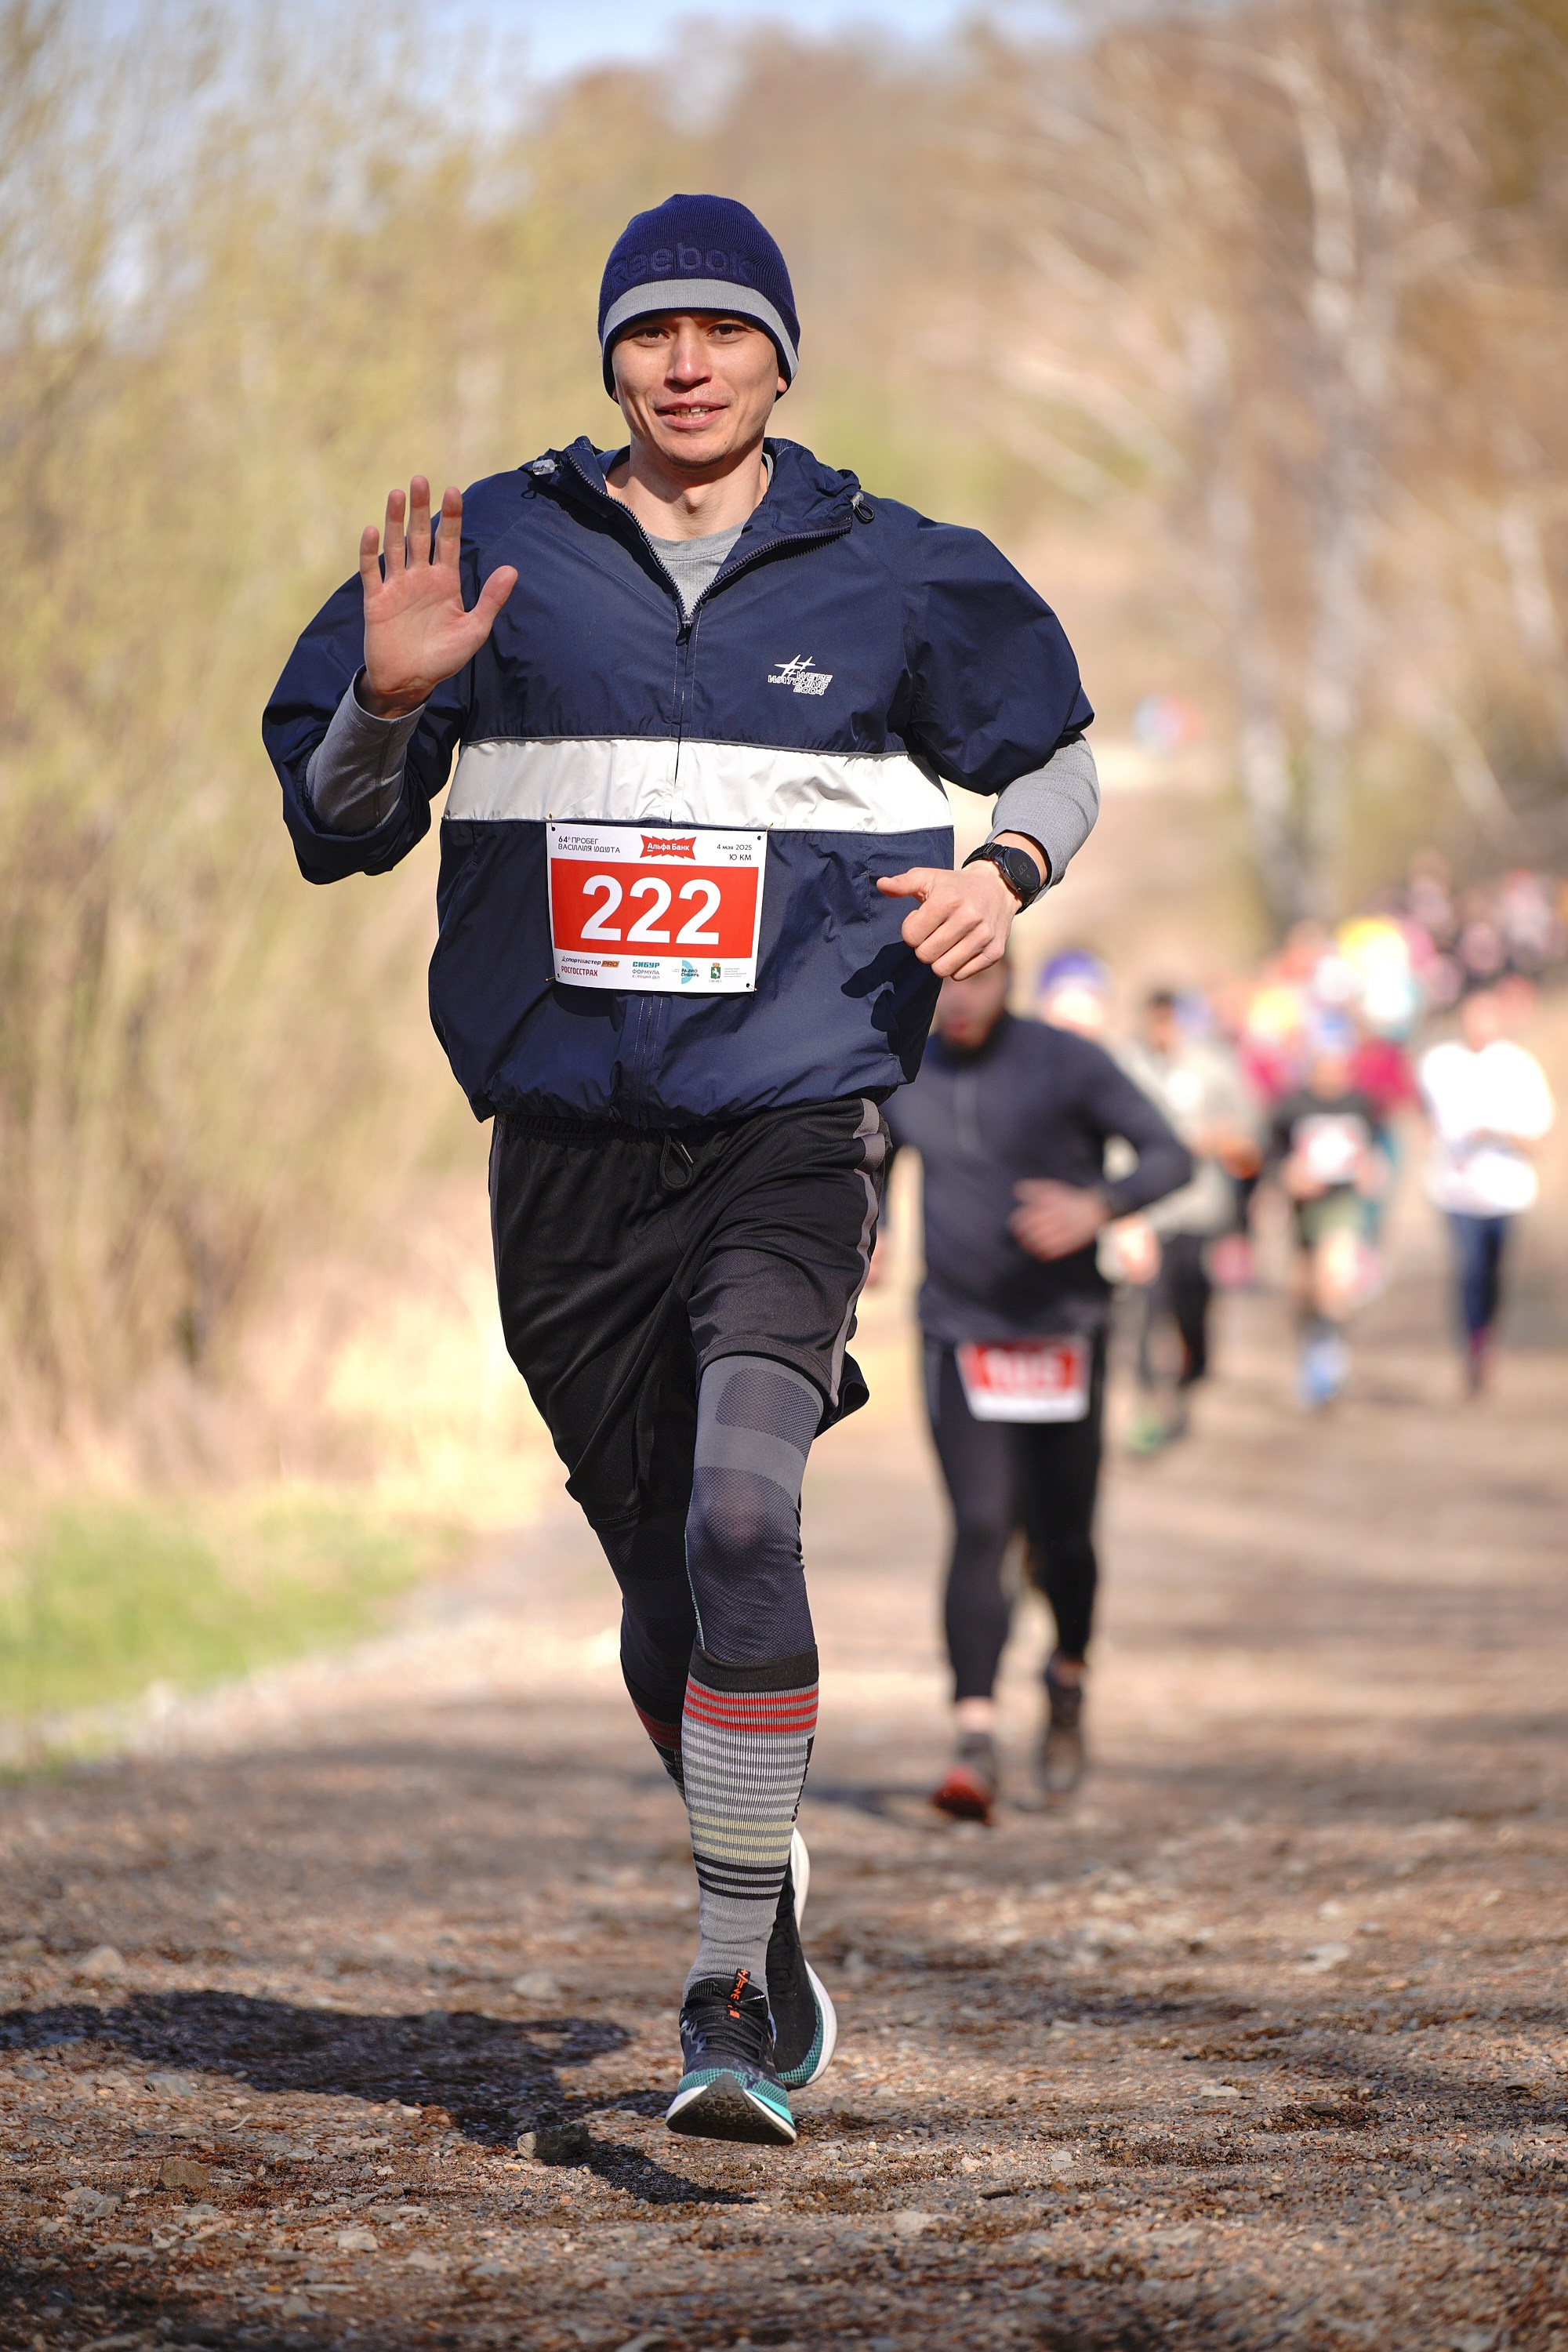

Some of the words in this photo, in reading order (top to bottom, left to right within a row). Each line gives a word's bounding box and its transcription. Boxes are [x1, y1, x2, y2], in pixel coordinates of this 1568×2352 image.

[558, 844, 592, 852] ВАСИЛИЯ
[647, 842, 670, 851] Альфа
[580, 874, 721, 946] 222
[561, 965, 598, 977] РОСГОССТРАХ
